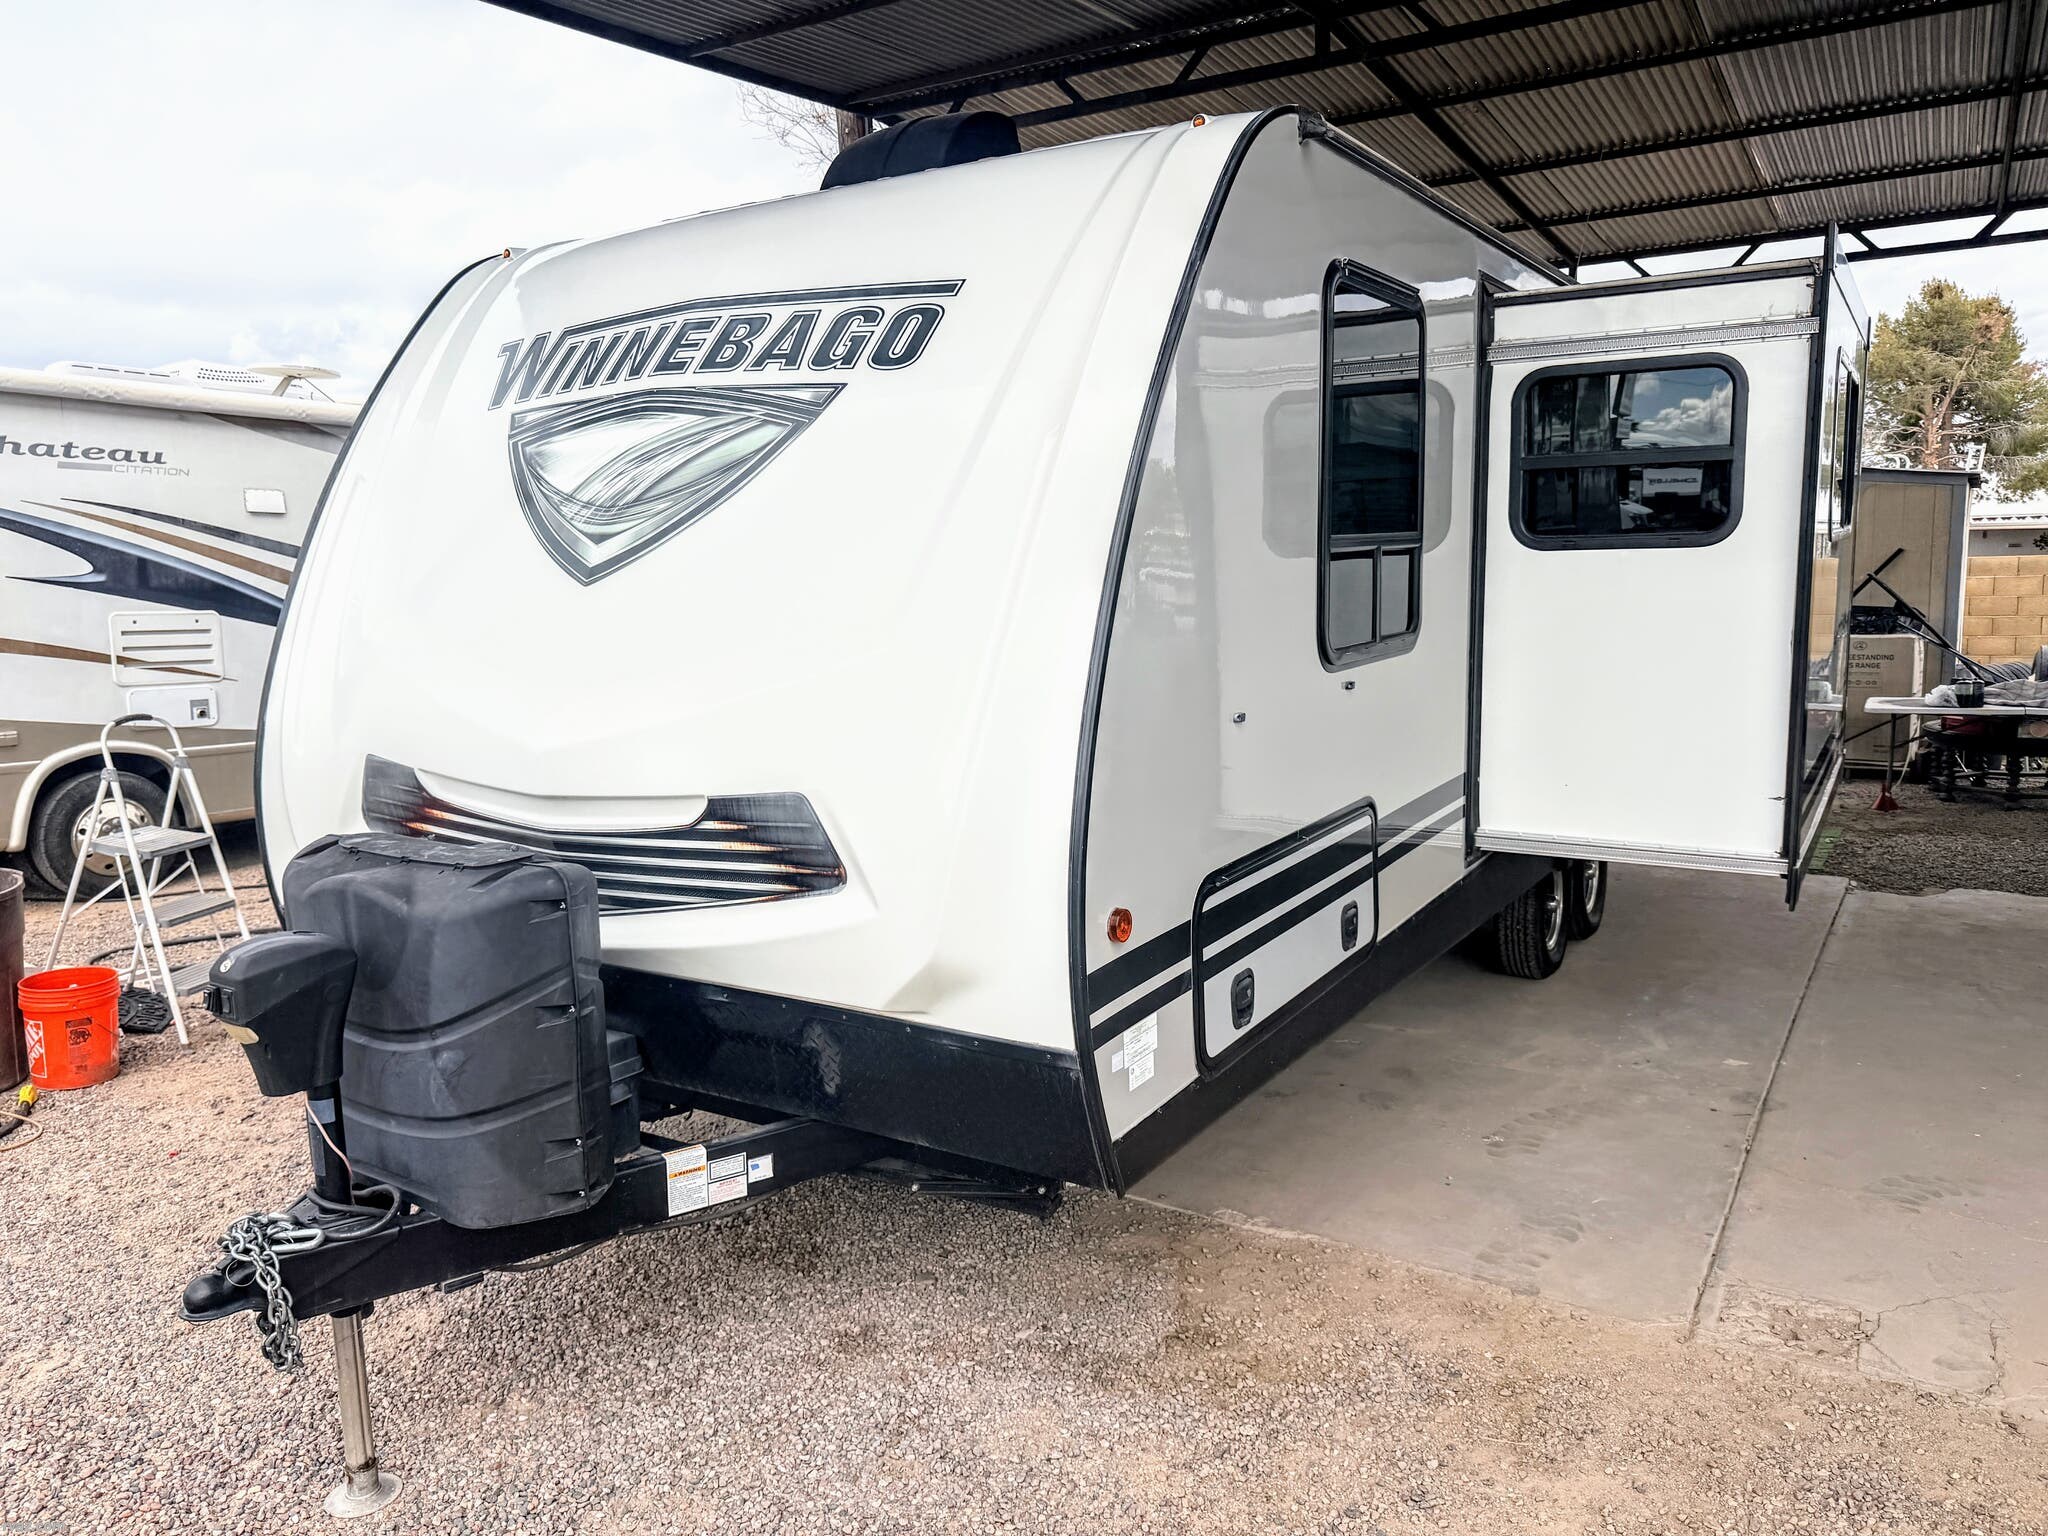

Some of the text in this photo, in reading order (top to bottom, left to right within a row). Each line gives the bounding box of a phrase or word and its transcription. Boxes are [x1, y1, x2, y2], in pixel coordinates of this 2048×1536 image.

[488, 302, 945, 410] WINNEBAGO
[0, 435, 167, 464] hateau
[113, 463, 190, 477] CITATION
[678, 1166, 702, 1177] WARNING
